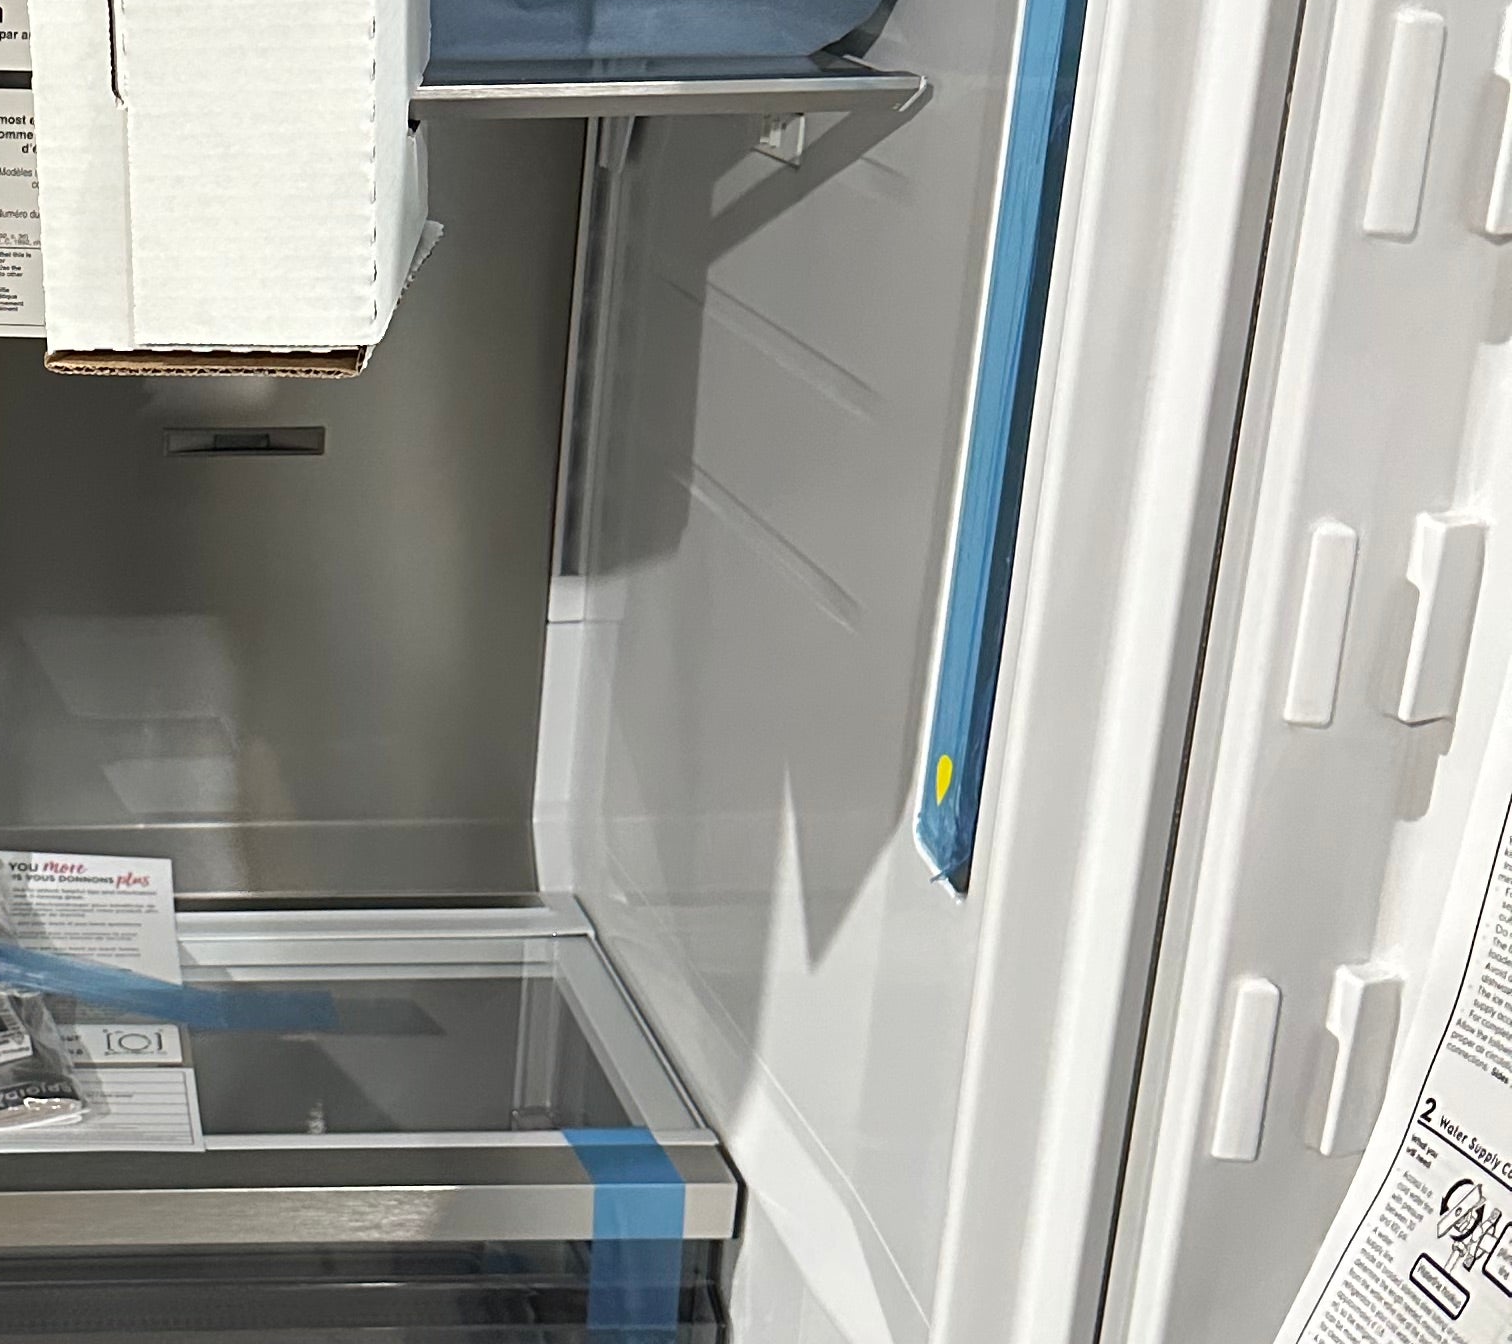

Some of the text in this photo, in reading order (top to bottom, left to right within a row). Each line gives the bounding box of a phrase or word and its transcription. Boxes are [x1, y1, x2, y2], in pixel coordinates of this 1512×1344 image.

[0, 31, 18, 42] par
[8, 861, 88, 874] YOU more
[116, 873, 150, 889] plus
[1420, 1097, 1437, 1123] 2
[1440, 1115, 1468, 1144] Water
[1468, 1137, 1501, 1171] Supply
